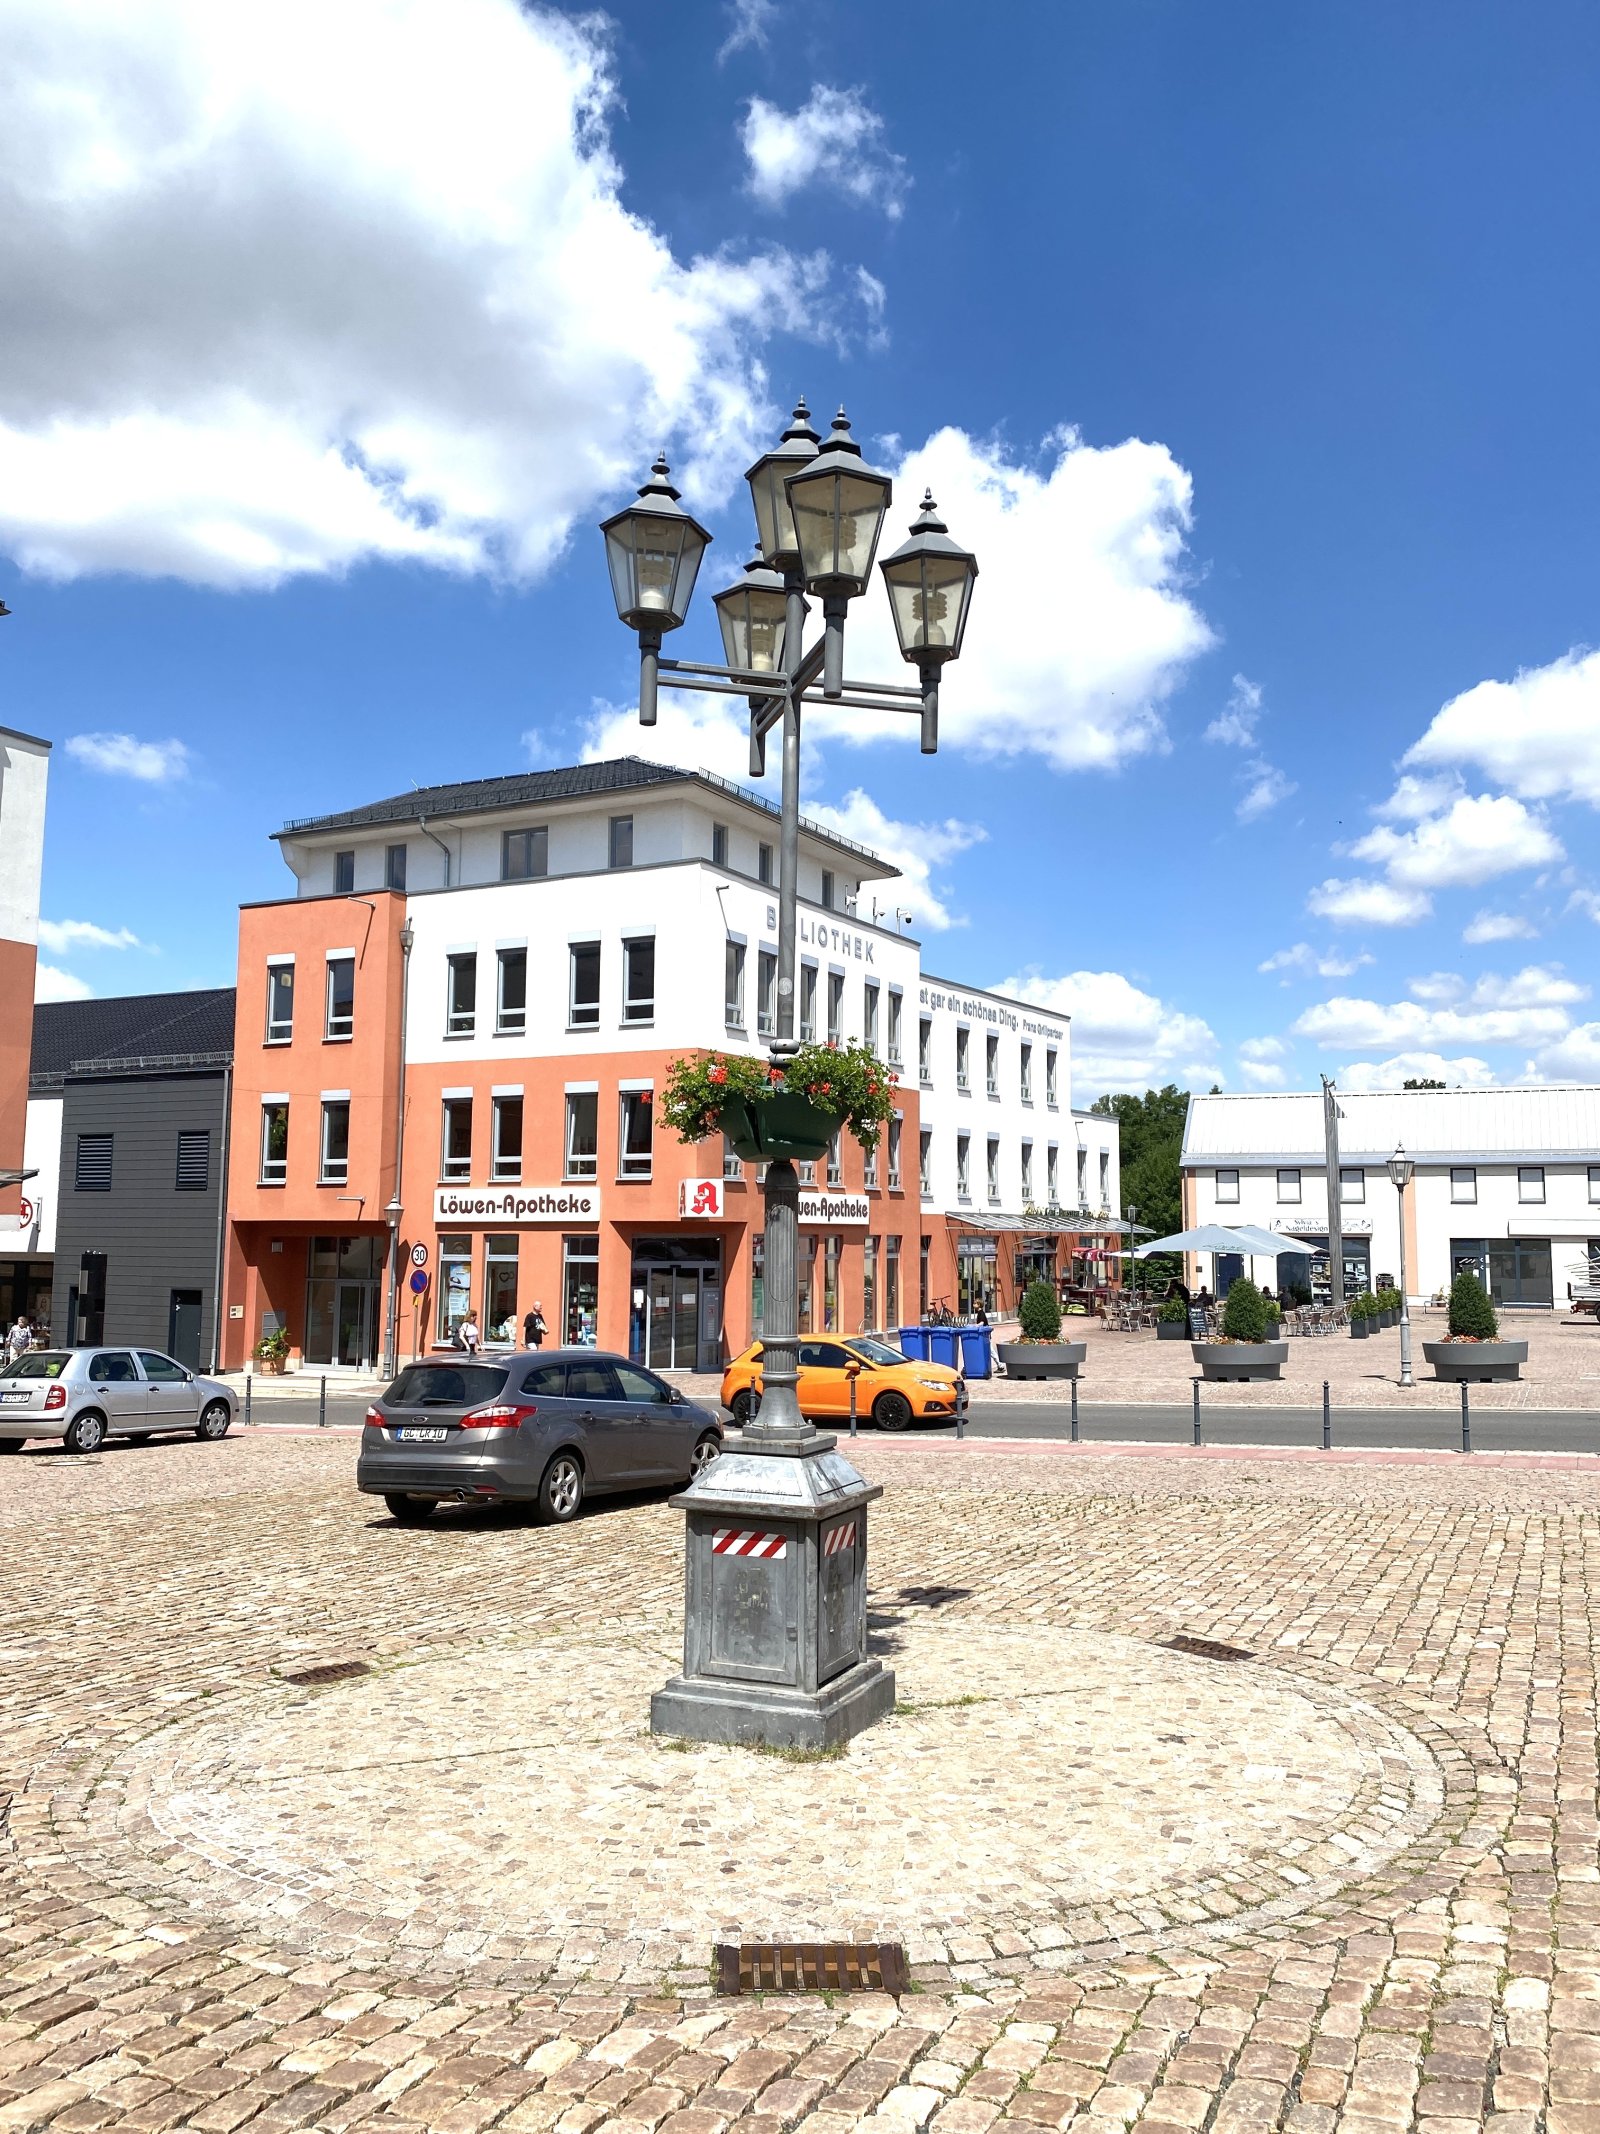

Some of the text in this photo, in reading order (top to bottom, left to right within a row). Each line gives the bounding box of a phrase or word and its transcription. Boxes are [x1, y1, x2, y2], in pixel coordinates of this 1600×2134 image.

[766, 904, 874, 965] BLIOTHEK
[919, 987, 929, 1005] st
[930, 991, 946, 1011] gar
[947, 994, 961, 1013] ein
[963, 999, 997, 1023] schönes
[999, 1007, 1019, 1032] Ding.
[439, 1194, 592, 1219] Löwen-Apotheke
[798, 1196, 869, 1222] wen-Apotheke
[414, 1249, 425, 1261] 30
